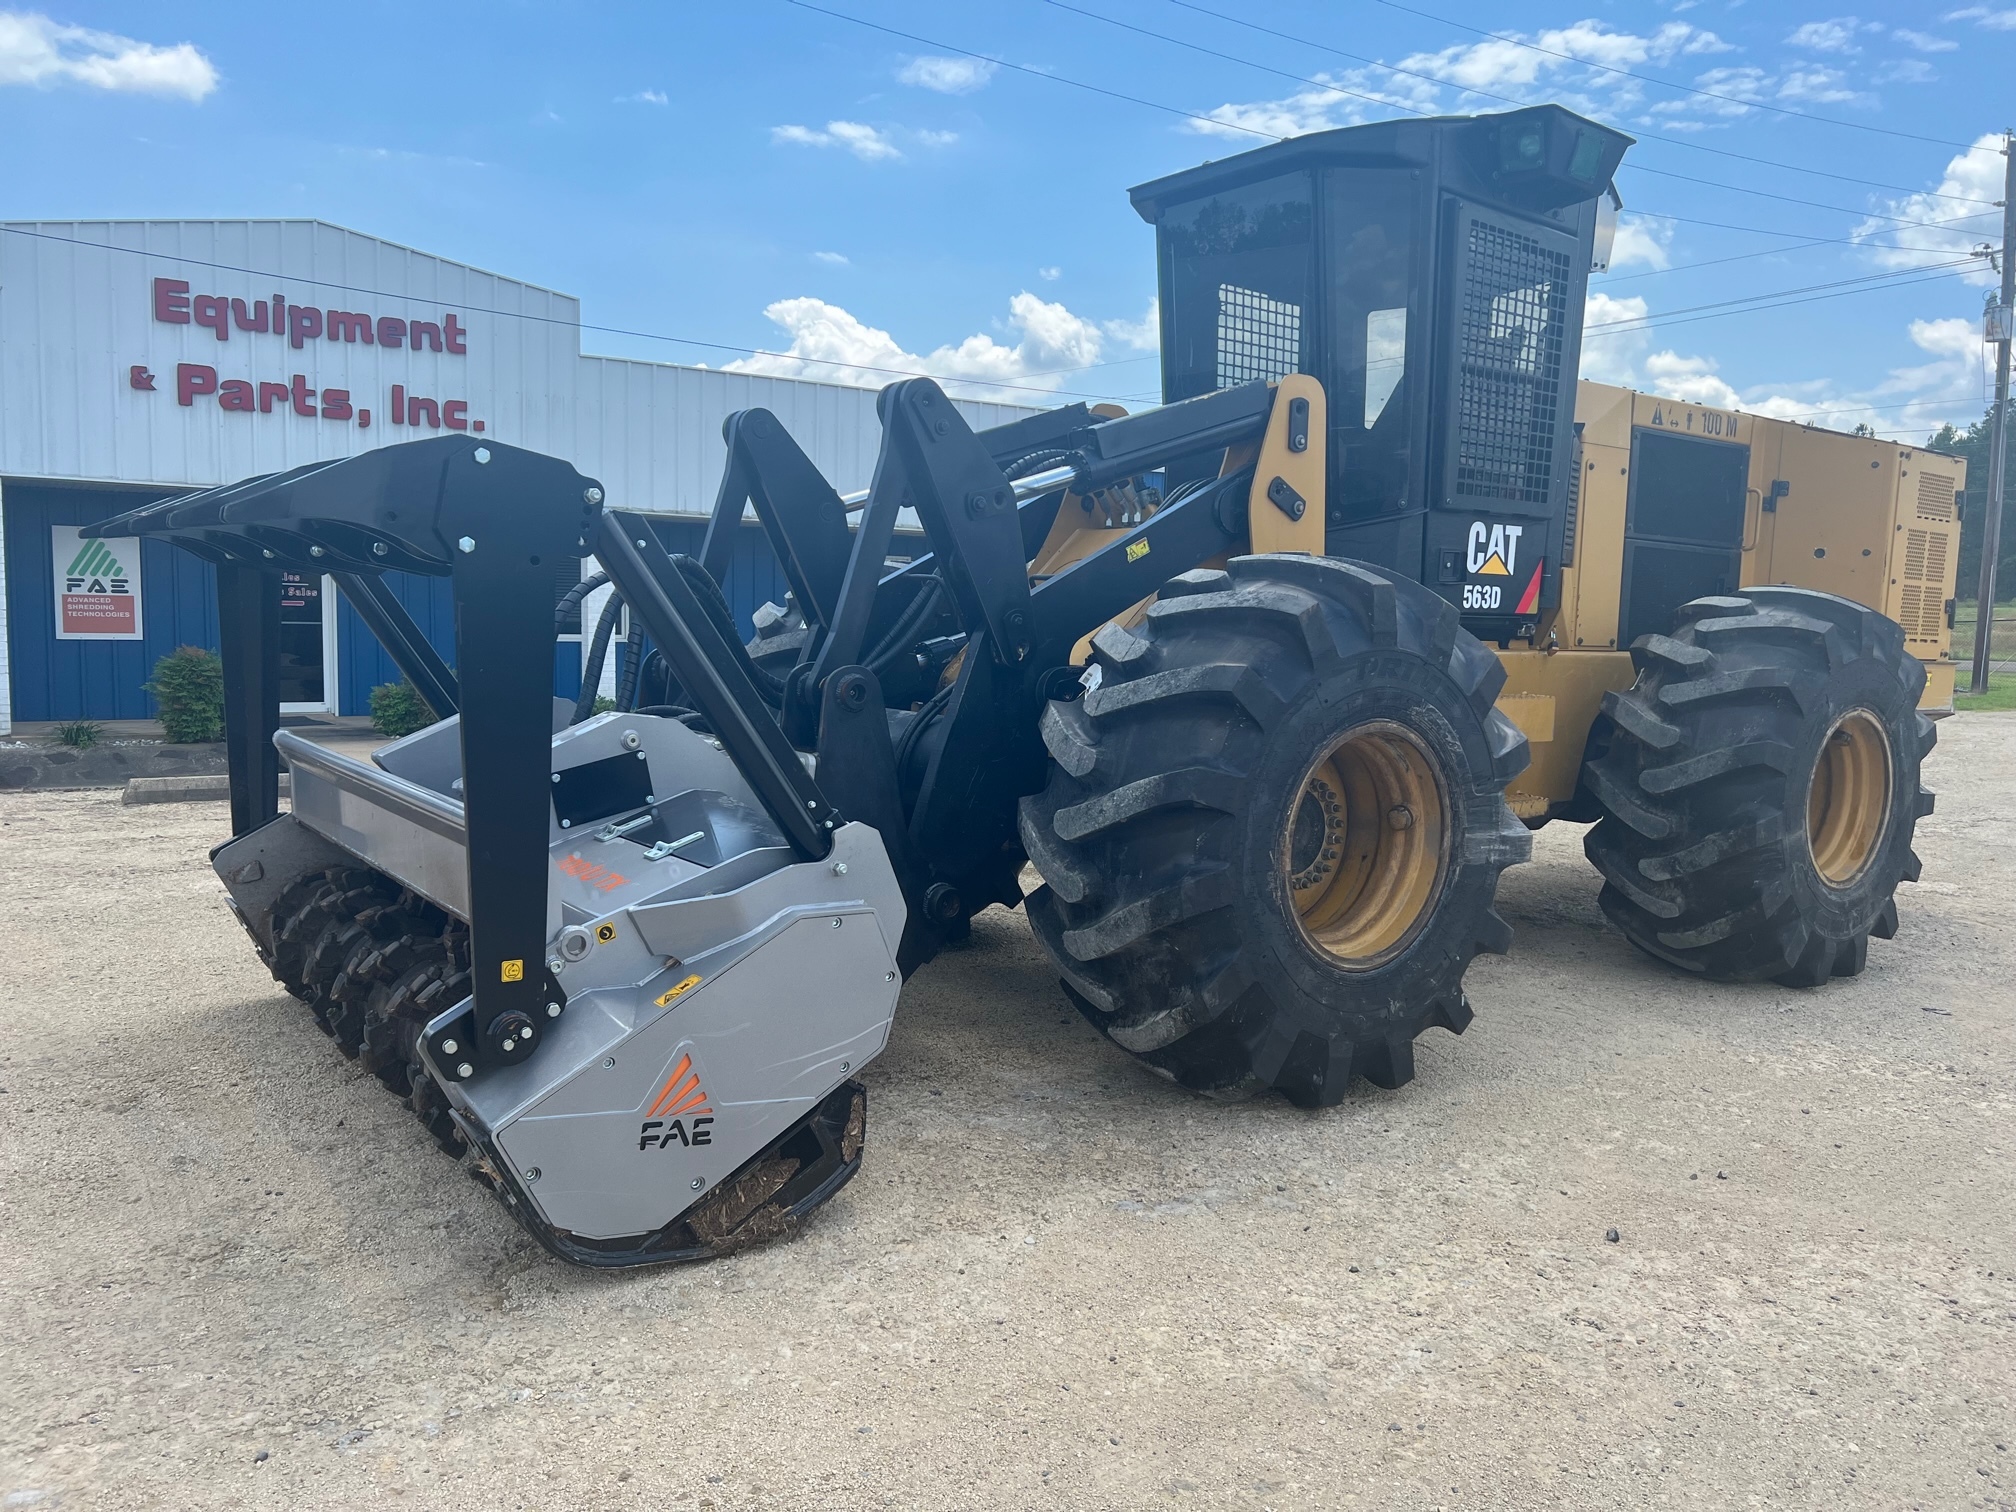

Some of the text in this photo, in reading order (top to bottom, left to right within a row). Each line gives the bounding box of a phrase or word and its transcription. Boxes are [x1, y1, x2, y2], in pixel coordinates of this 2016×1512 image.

[154, 277, 467, 355] Equipment
[130, 363, 485, 431] & Parts, Inc.
[1702, 411, 1738, 438] 100 M
[1466, 521, 1523, 576] CAT
[66, 578, 129, 594] FAE
[1463, 585, 1502, 609] 563D
[640, 1117, 714, 1151] FAE
